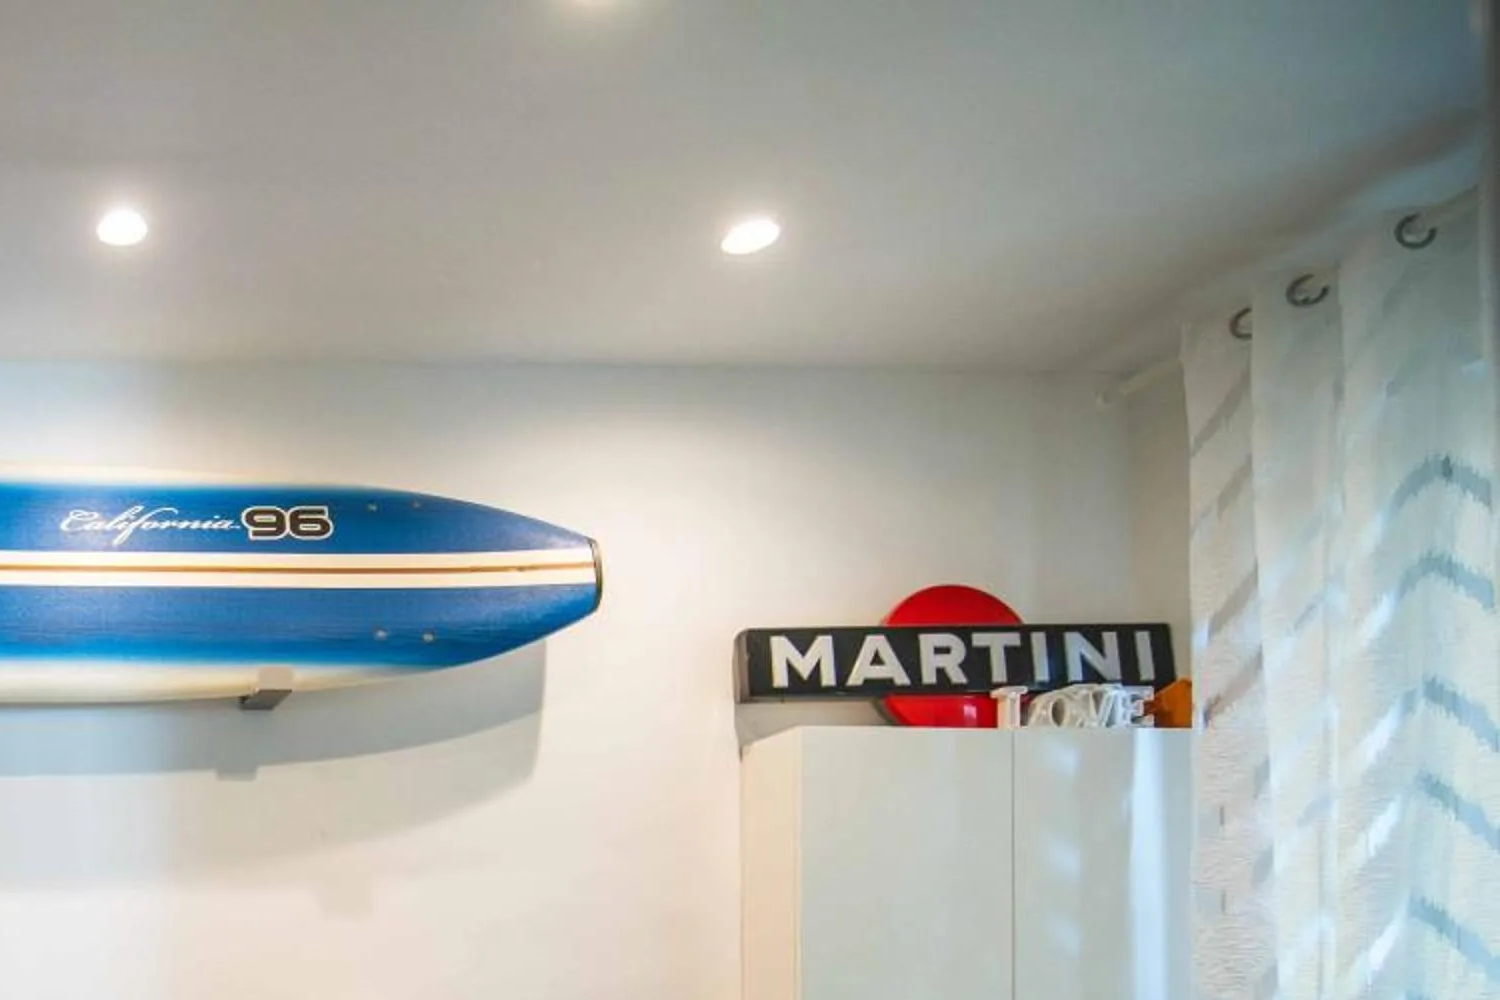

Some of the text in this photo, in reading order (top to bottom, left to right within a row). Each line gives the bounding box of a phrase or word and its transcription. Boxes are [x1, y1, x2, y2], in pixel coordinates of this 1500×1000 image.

[60, 505, 334, 545] California 96
[770, 631, 1156, 688] MARTINI
